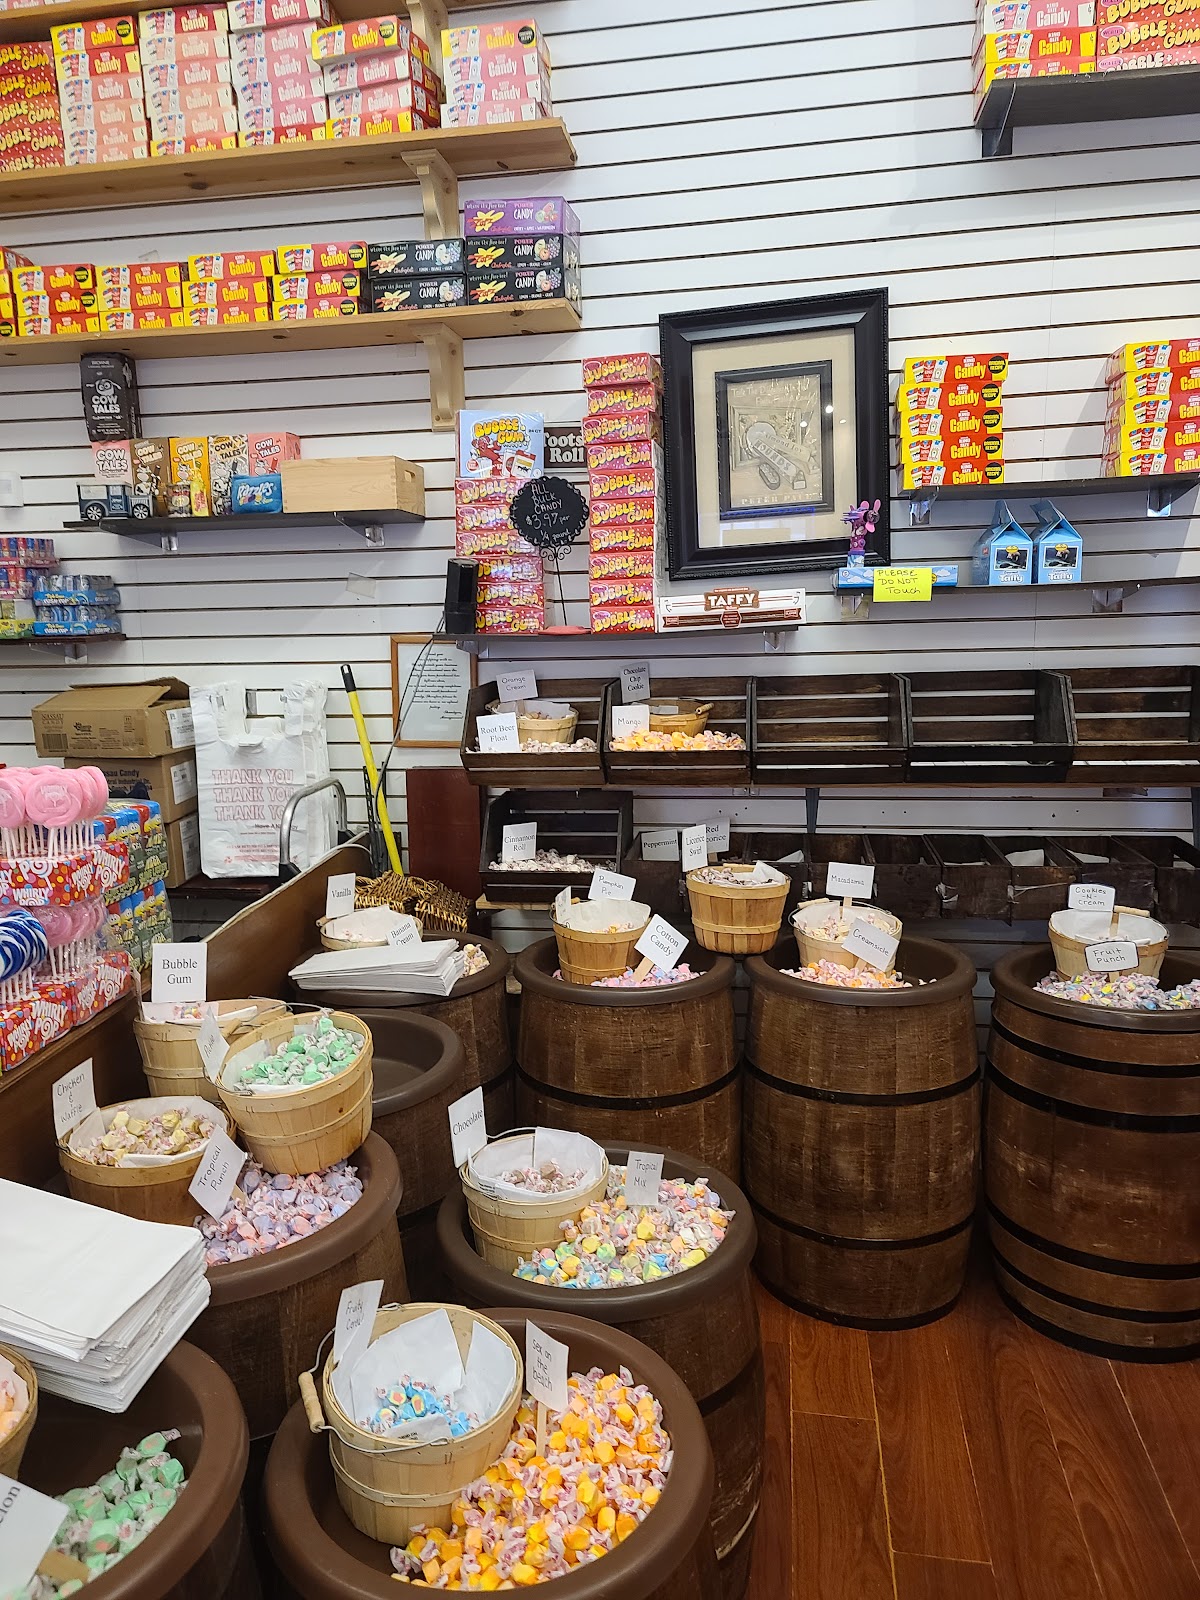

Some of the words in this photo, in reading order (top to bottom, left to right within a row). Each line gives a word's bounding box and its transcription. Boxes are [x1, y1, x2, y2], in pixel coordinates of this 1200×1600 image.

[271, 1, 300, 20] Candy
[1036, 7, 1071, 27] Candy
[180, 13, 209, 32] Candy
[91, 27, 117, 46] Candy
[352, 28, 378, 48] Candy
[485, 30, 515, 49] Candy
[1106, 19, 1168, 55] BUBBLE
[1038, 36, 1073, 57] Candy
[21, 52, 50, 71] GUM
[94, 56, 121, 74] Candy
[487, 58, 517, 78] Candy
[363, 61, 390, 83] Candy
[25, 80, 52, 98] GUM
[28, 106, 55, 125] GUM
[365, 117, 393, 136] Candy
[31, 134, 59, 152] GUM
[513, 208, 534, 220] CANDY
[320, 250, 348, 268] Candy
[415, 249, 435, 261] CANDY
[513, 244, 534, 257] CANDY
[229, 259, 256, 276] Candy
[49, 272, 74, 289] Candy
[314, 279, 342, 296] Candy
[515, 277, 535, 289] CANDY
[136, 291, 163, 307] Candy
[222, 285, 249, 302] Candy
[419, 287, 439, 299] CANDY
[54, 296, 80, 313] Candy
[620, 363, 647, 381] GUM
[954, 361, 987, 380] Candy
[91, 395, 118, 405] COW
[589, 389, 634, 413] BUBBLE
[625, 394, 652, 411] GUM
[948, 389, 980, 407] Candy
[92, 404, 121, 414] TALES
[474, 417, 519, 437] BUBBLE
[620, 423, 646, 439] GUM
[949, 415, 981, 433] Candy
[255, 438, 273, 450] COW
[497, 430, 525, 445] GUM
[543, 430, 585, 448] Toots
[96, 449, 126, 460] COW
[137, 444, 155, 457] COW
[177, 443, 195, 455] COW
[214, 441, 234, 453] COW
[219, 448, 241, 461] TALES
[259, 445, 281, 458] TALES
[550, 446, 585, 463] Roll
[950, 442, 982, 459] Candy
[141, 450, 163, 464] TALES
[588, 443, 633, 469] BUBBLE
[623, 450, 651, 466] GUM
[96, 459, 129, 471] TALES
[952, 468, 984, 485] Candy
[531, 483, 549, 496] ALL
[591, 473, 637, 498] BUBBLE
[627, 480, 654, 496] GUM
[534, 500, 563, 515] CANDY
[591, 501, 636, 525] BUBBLE
[626, 508, 654, 524] GUM
[591, 529, 636, 552] BUBBLE
[627, 535, 654, 550] GUM
[876, 569, 918, 578] PLEASE
[877, 578, 895, 586] DO
[897, 577, 919, 585] NOT
[592, 583, 635, 607] BUBBLE
[625, 589, 652, 605] GUM
[708, 593, 756, 606] TAFFY
[593, 609, 636, 632] BUBBLE
[627, 616, 654, 632] GUM
[622, 666, 648, 677] Chocolate
[480, 725, 498, 736] Root
[498, 723, 516, 734] Beer
[616, 716, 643, 727] Mango
[489, 733, 509, 743] Float
[211, 768, 264, 786] THANK
[266, 768, 295, 785] YOU
[213, 786, 265, 804] THANK
[214, 804, 266, 822] THANK
[705, 824, 720, 834] Red
[503, 833, 536, 845] Cinnamon
[643, 838, 679, 850] Peppermint
[512, 843, 527, 853] Roll
[93, 848, 126, 880] WHIRLY
[12, 887, 50, 902] WHIRLY
[331, 887, 353, 900] Vanilla
[1074, 885, 1107, 895] Cookies
[389, 921, 413, 940] Banana
[654, 923, 680, 949] Cotton
[649, 932, 675, 958] Candy
[1092, 947, 1123, 958] Fruit
[161, 957, 199, 970] Bubble
[95, 964, 128, 990] WHIRLY
[166, 973, 193, 986] Gum
[29, 1000, 68, 1028] WHIRLY
[7, 1016, 33, 1049] WHIRLY
[55, 1071, 86, 1098] Chicken
[452, 1108, 485, 1137] Chocolate
[198, 1144, 223, 1188] Tropical
[210, 1161, 230, 1192] Punch
